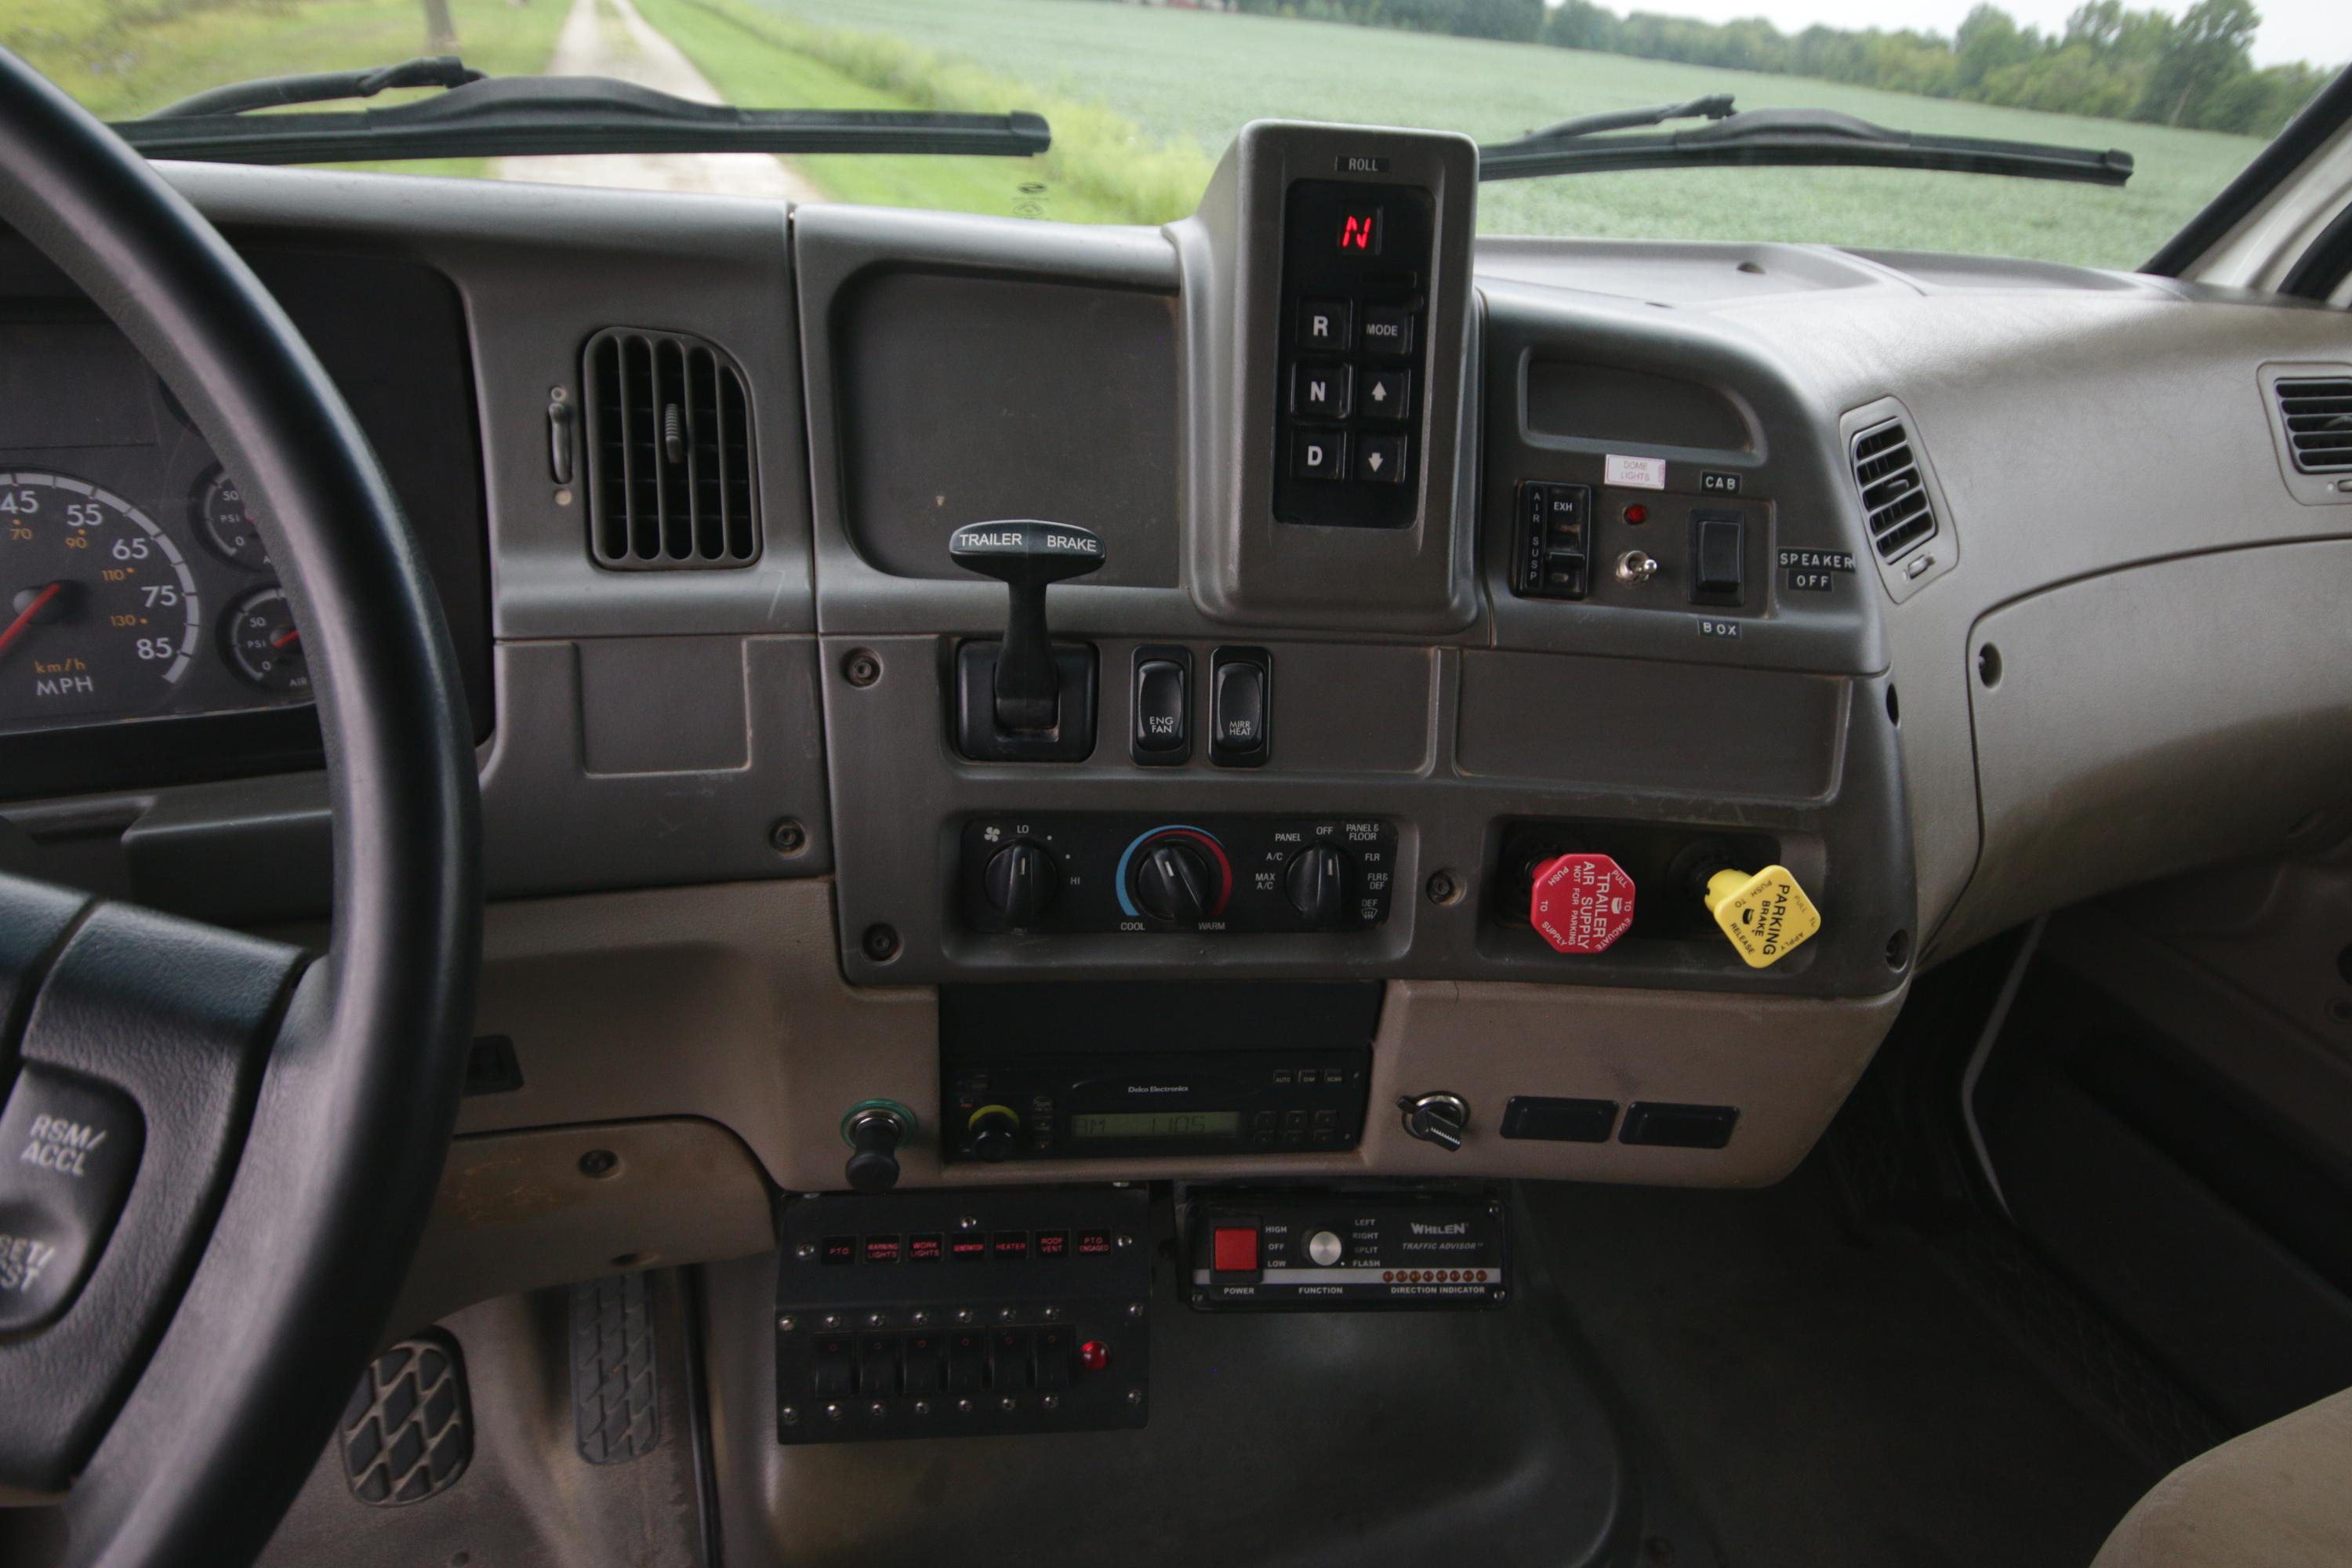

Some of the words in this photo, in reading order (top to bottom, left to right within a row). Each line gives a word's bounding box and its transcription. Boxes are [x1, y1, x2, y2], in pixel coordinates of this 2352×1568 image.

[1348, 158, 1378, 172] ROLL
[1342, 216, 1372, 249] N
[1313, 317, 1328, 337] R
[1367, 324, 1398, 337] MODE
[1310, 381, 1326, 401] N
[1308, 446, 1323, 466] D
[1624, 461, 1648, 470] DOME
[1621, 471, 1650, 481] LIGHTS
[1705, 477, 1736, 490] CAB
[0, 491, 38, 514] 45
[1554, 502, 1573, 511] EXH
[67, 504, 103, 526] 55
[12, 528, 32, 539] 70
[66, 538, 87, 548] 90
[112, 538, 149, 560] 65
[960, 533, 1022, 546] TRAILER
[1047, 535, 1096, 551] BRAKE
[1780, 553, 1852, 568] SPEAKER
[102, 570, 125, 581] 110
[1796, 575, 1828, 587] OFF
[141, 586, 177, 608] 75
[110, 615, 136, 626] 130
[250, 617, 266, 627] 50
[1703, 622, 1736, 636] BOX
[136, 638, 172, 659] 85
[35, 659, 86, 673] km/h
[36, 676, 93, 696] MPH
[289, 678, 307, 687] AIR
[1149, 717, 1174, 725] ENG
[1229, 720, 1250, 729] MIRR
[1152, 725, 1172, 734] FAN
[1017, 825, 1029, 833] LO
[1316, 826, 1334, 835] OFF
[1346, 824, 1370, 833] PANEL
[1275, 833, 1301, 842] PANEL
[1348, 833, 1377, 841] FLOOR
[1255, 873, 1276, 881] MAX
[1547, 866, 1570, 887] PUSH
[1582, 861, 1595, 885] AIR
[1610, 869, 1628, 888] PULL
[1070, 877, 1080, 885] HI
[1370, 881, 1385, 890] DEF
[1751, 880, 1773, 898] PUSH
[1571, 887, 1581, 906] FOR
[1540, 900, 1548, 912] TO
[1593, 872, 1610, 938] TRAILER
[1624, 900, 1632, 912] TO
[1577, 896, 1594, 949] SUPPLY
[1755, 900, 1771, 937] BRAKE
[1762, 884, 1791, 955] PARKING
[1120, 922, 1145, 931] COOL
[1198, 922, 1225, 931] WARM
[1541, 921, 1567, 946] SUPPLY
[1568, 909, 1579, 946] PARKING
[1595, 917, 1632, 950] EVACUATE
[1730, 922, 1756, 955] RELEASE
[30, 1114, 107, 1151] RSM/
[20, 1141, 85, 1176] ACCL
